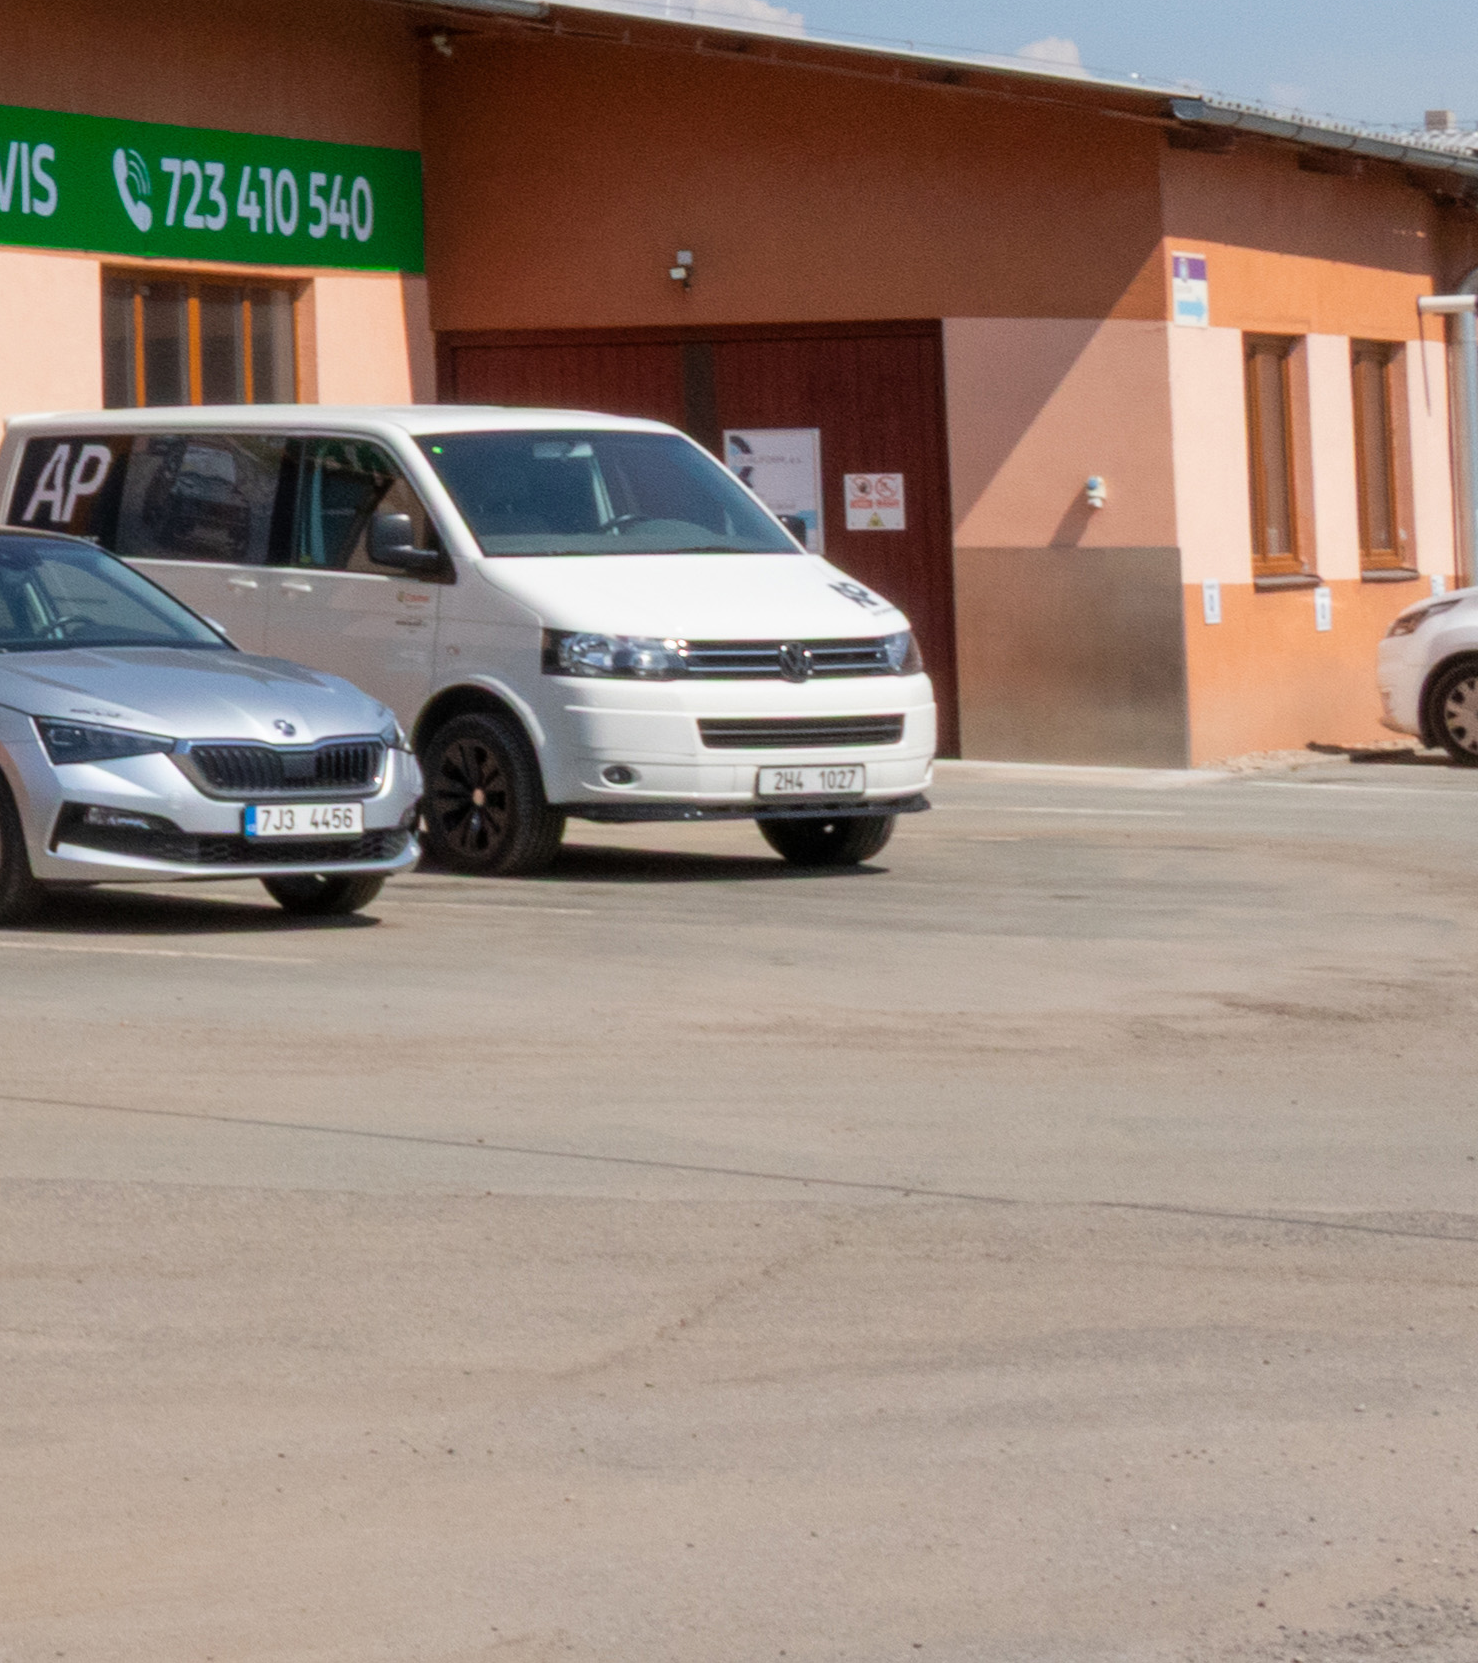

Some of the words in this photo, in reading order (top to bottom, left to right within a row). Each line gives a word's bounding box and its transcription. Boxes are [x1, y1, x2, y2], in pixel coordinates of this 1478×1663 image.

[160, 157, 227, 232] 723
[236, 166, 299, 237] 410
[308, 171, 374, 243] 540
[22, 444, 112, 522] AP
[774, 770, 804, 791] 2H4
[819, 769, 856, 790] 1027
[261, 809, 295, 832] 7J3
[309, 808, 353, 829] 4456
